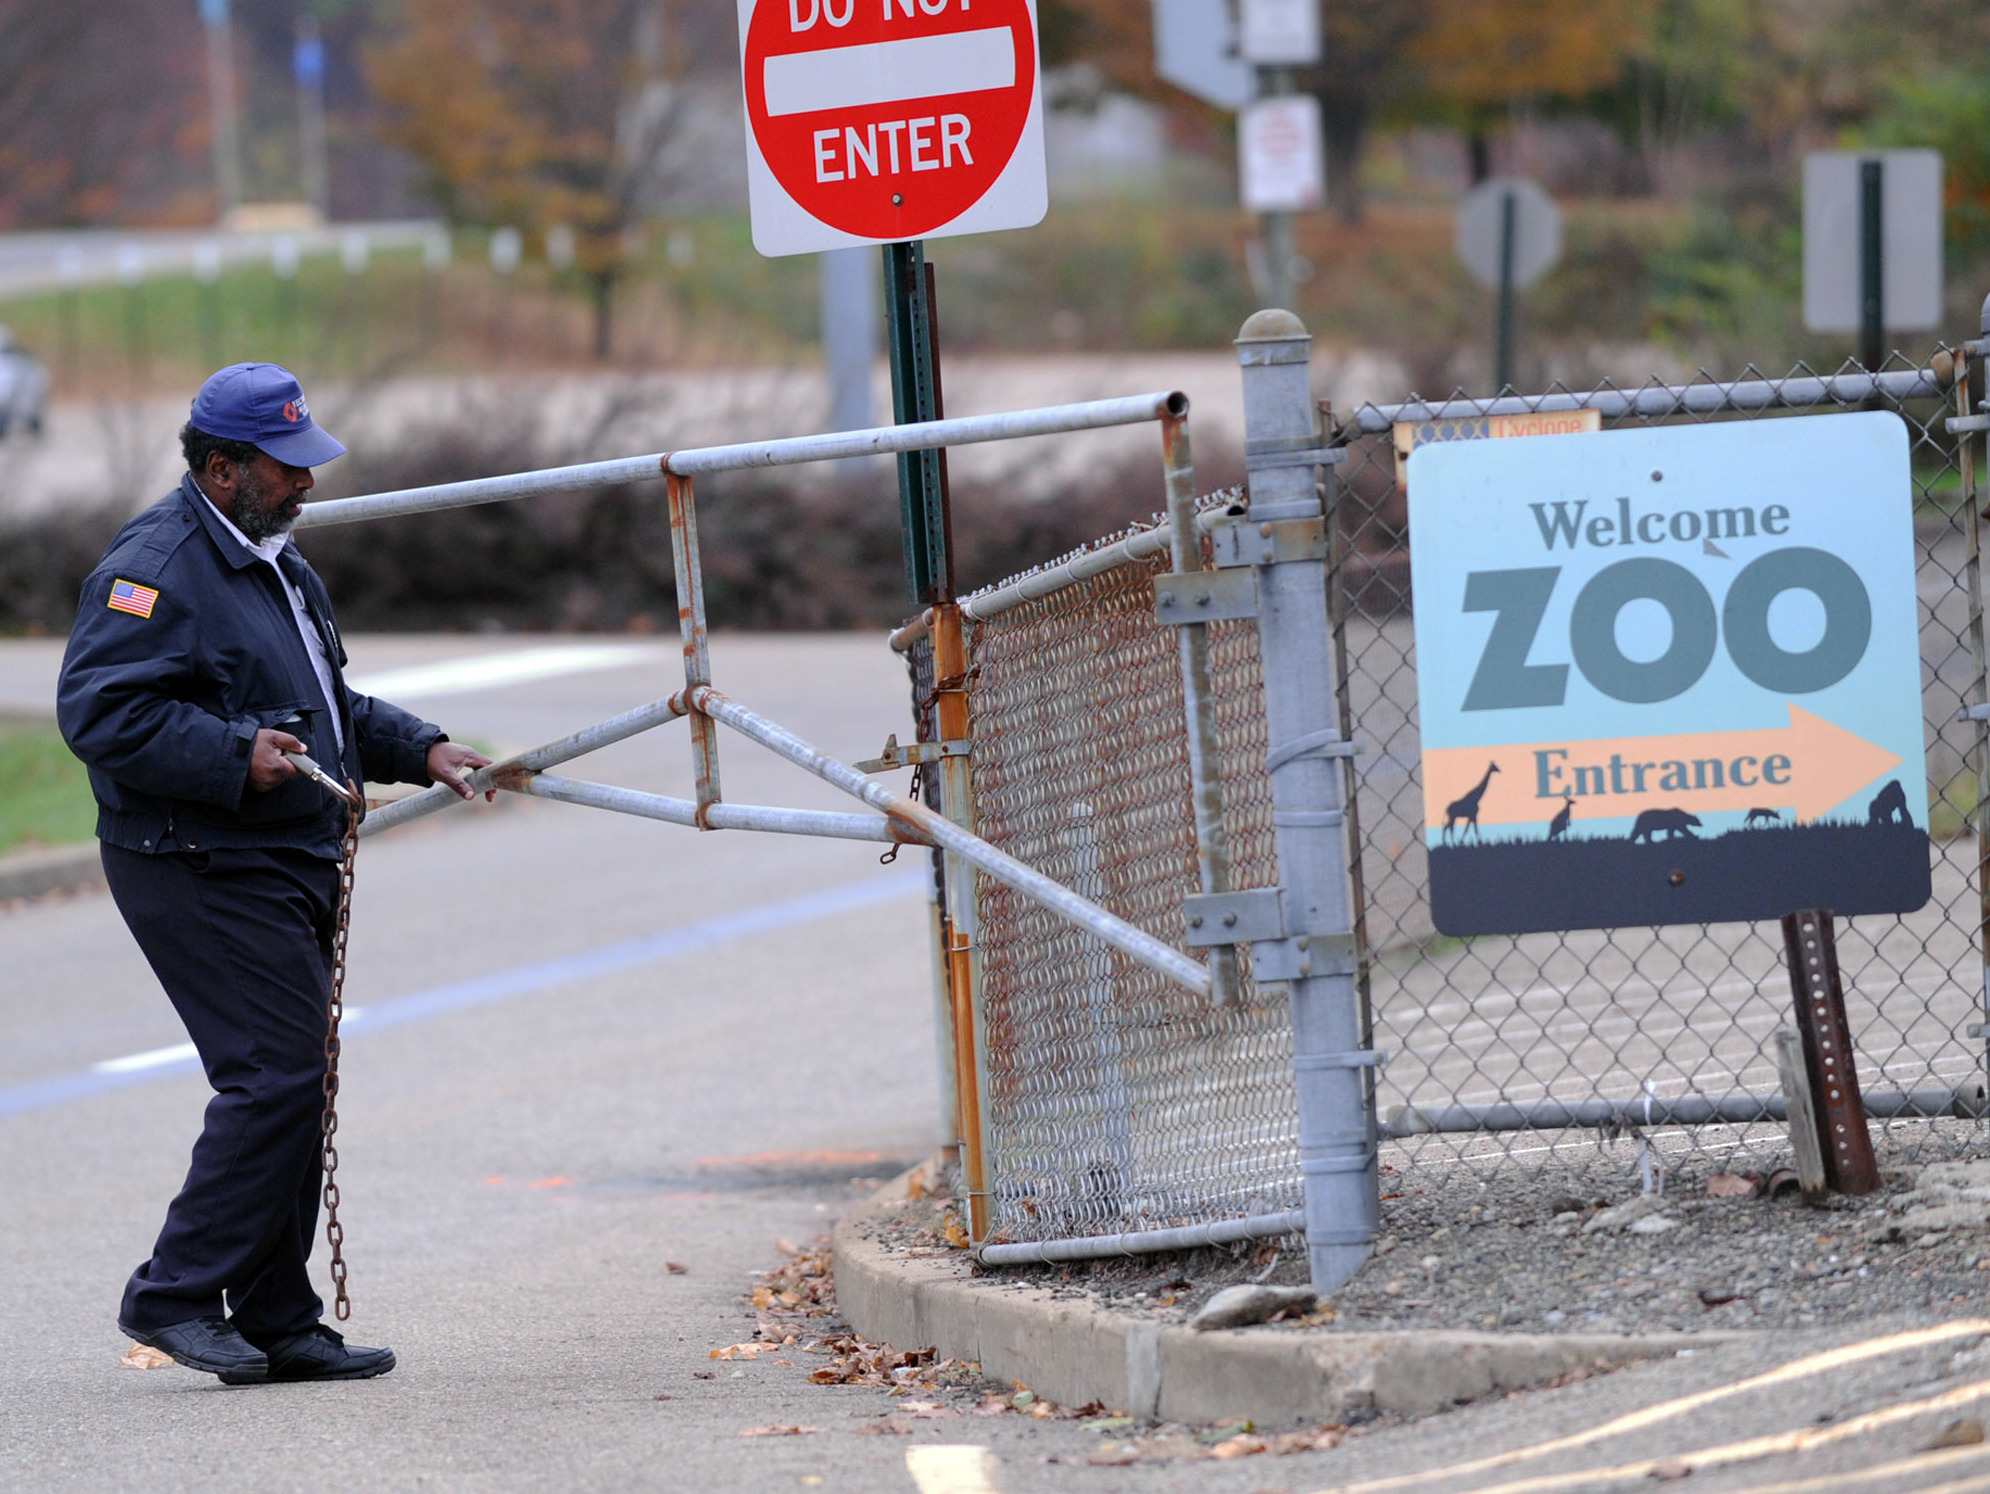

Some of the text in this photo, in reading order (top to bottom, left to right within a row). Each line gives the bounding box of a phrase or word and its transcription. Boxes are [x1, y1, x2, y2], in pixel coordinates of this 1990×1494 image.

[813, 113, 974, 184] ENTER
[1528, 497, 1791, 551] Welcome
[1460, 546, 1873, 713] ZOO
[1533, 749, 1792, 799] Entrance
